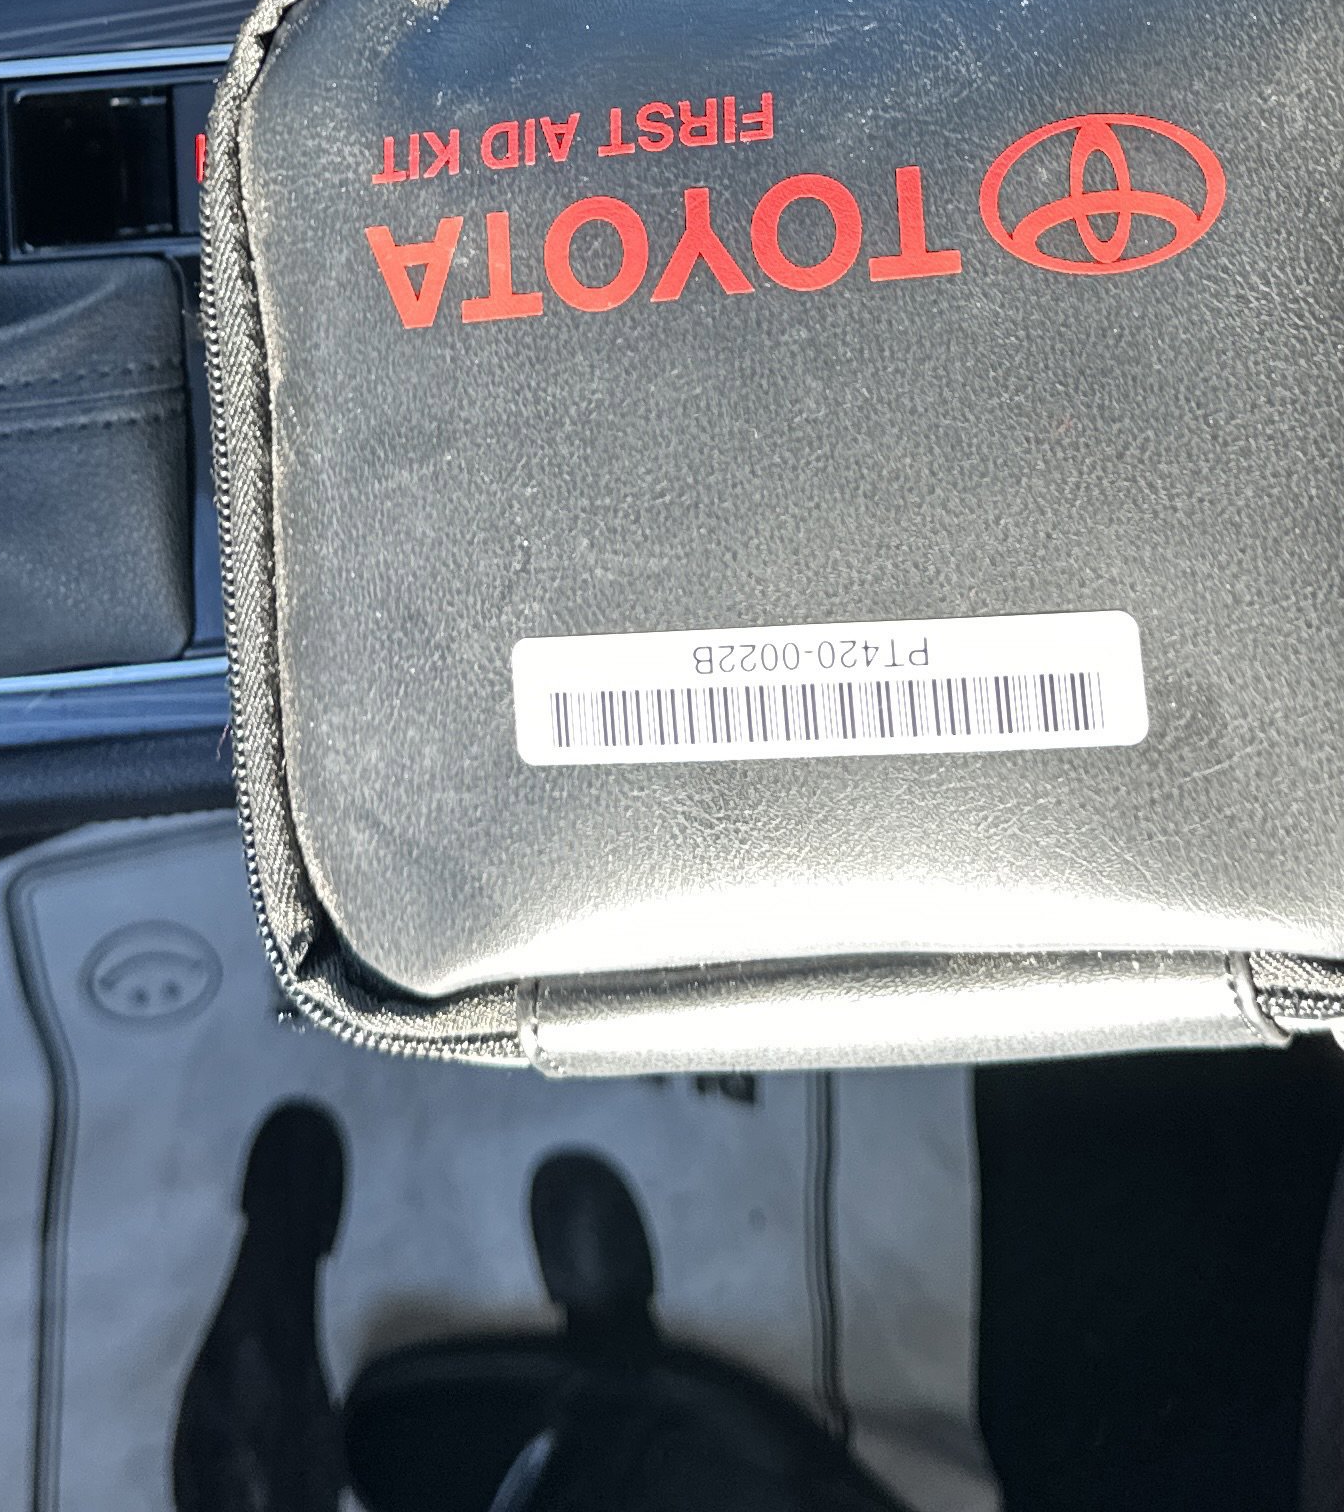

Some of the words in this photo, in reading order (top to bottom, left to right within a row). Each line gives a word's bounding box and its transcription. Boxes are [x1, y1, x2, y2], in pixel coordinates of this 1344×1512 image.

[481, 114, 579, 168] AID
[598, 93, 773, 156] FIRST
[373, 130, 459, 184] KIT
[366, 166, 962, 328] TOYOTA
[693, 637, 929, 674] PT420-0022B
